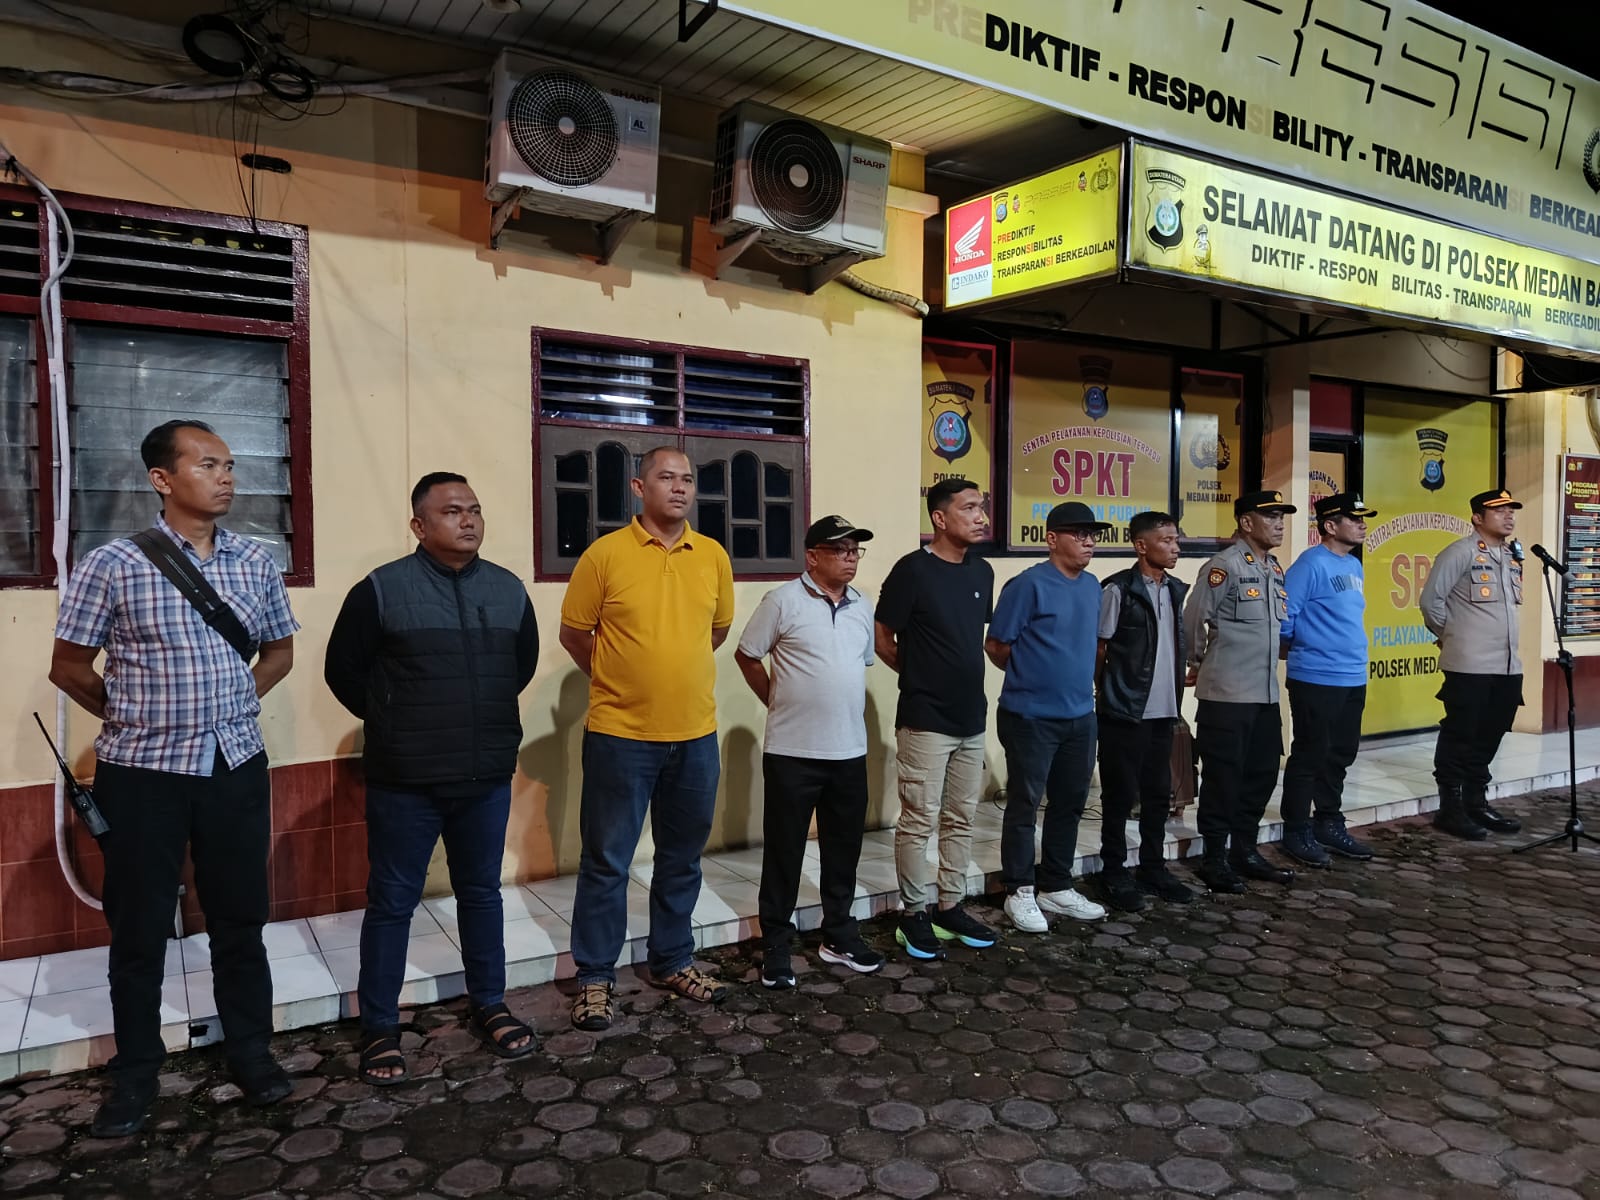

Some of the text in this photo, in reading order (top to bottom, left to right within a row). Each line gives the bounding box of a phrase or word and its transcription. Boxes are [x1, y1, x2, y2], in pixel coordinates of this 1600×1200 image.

[1128, 62, 1354, 161] RESPONSIBILITY
[852, 156, 886, 169] SHARP
[997, 224, 1036, 245] PREDIKTIF
[1203, 185, 1322, 244] SELAMAT
[1328, 215, 1415, 265] DATANG
[1421, 238, 1441, 273] DI
[1447, 245, 1520, 291] POLSEK
[1524, 264, 1582, 304] MEDAN
[954, 249, 986, 264] HONDA
[997, 235, 1063, 262] RESPONSIBILITAS
[997, 255, 1054, 280] TRANSPARANSI
[1055, 239, 1116, 264] BERKEADILAN
[960, 269, 989, 285] INDAKO
[1251, 244, 1306, 271] DIKTIF
[1318, 258, 1379, 288] RESPON
[1391, 274, 1443, 300] BILITAS
[1453, 287, 1532, 319] TRANSPARAN
[1022, 426, 1161, 463] SENTRA PELAYANAN KEPOLISIAN TERPADU
[1052, 448, 1135, 497] SPKT
[1197, 480, 1222, 490] POLSEK
[1565, 481, 1572, 495] 9
[1186, 492, 1232, 503] MEDAN BARAT
[1366, 523, 1392, 553] SENTRA
[1392, 513, 1429, 534] PELAYANAN
[1430, 513, 1466, 536] KEPOLISIAN
[1369, 658, 1411, 679] POLSEK
